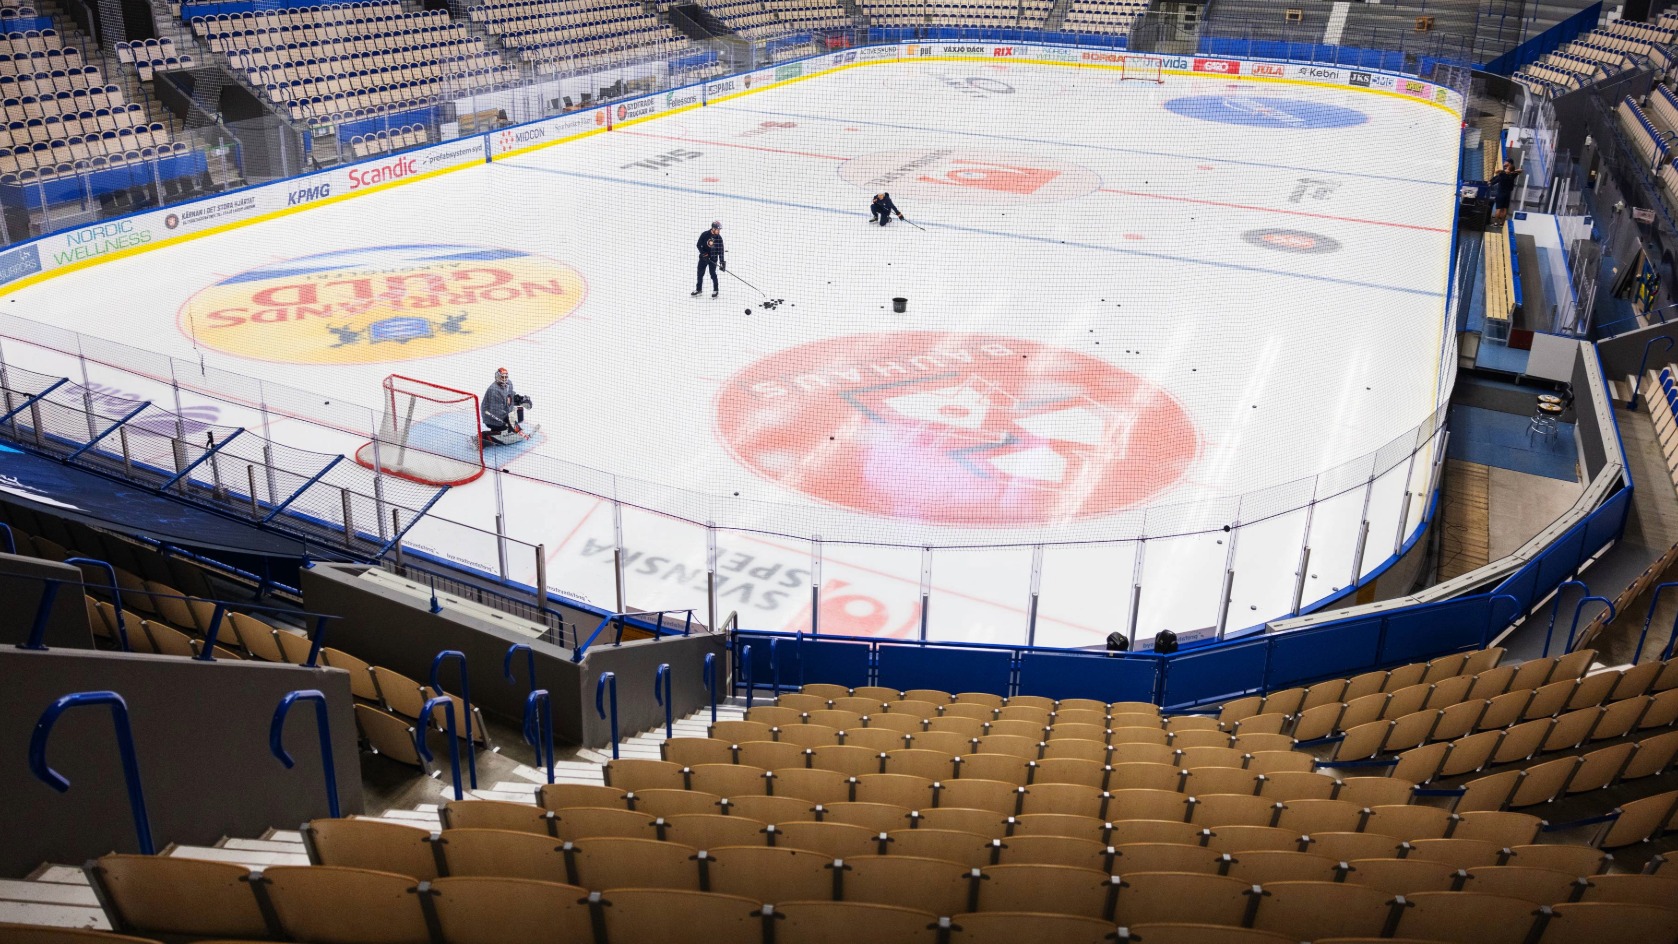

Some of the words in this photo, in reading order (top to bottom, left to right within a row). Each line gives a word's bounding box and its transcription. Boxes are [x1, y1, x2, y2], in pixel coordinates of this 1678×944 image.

[993, 47, 1014, 57] RIX
[1253, 65, 1283, 76] JULA
[1309, 68, 1339, 79] Kebni
[1350, 73, 1370, 83] JKS
[718, 81, 735, 93] PADEL
[515, 128, 545, 143] MIDCON
[429, 147, 471, 164] prefabsystem
[472, 144, 483, 156] syd
[348, 157, 418, 189] Scandic
[287, 183, 330, 206] KPMG
[67, 220, 133, 247] NORDIC
[53, 230, 152, 266] WELLNESS
[252, 267, 514, 306] GULD
[207, 279, 564, 329] NORRLANDS
[751, 342, 1014, 399] BAUHAUS
[579, 538, 789, 611] SVENSKA
